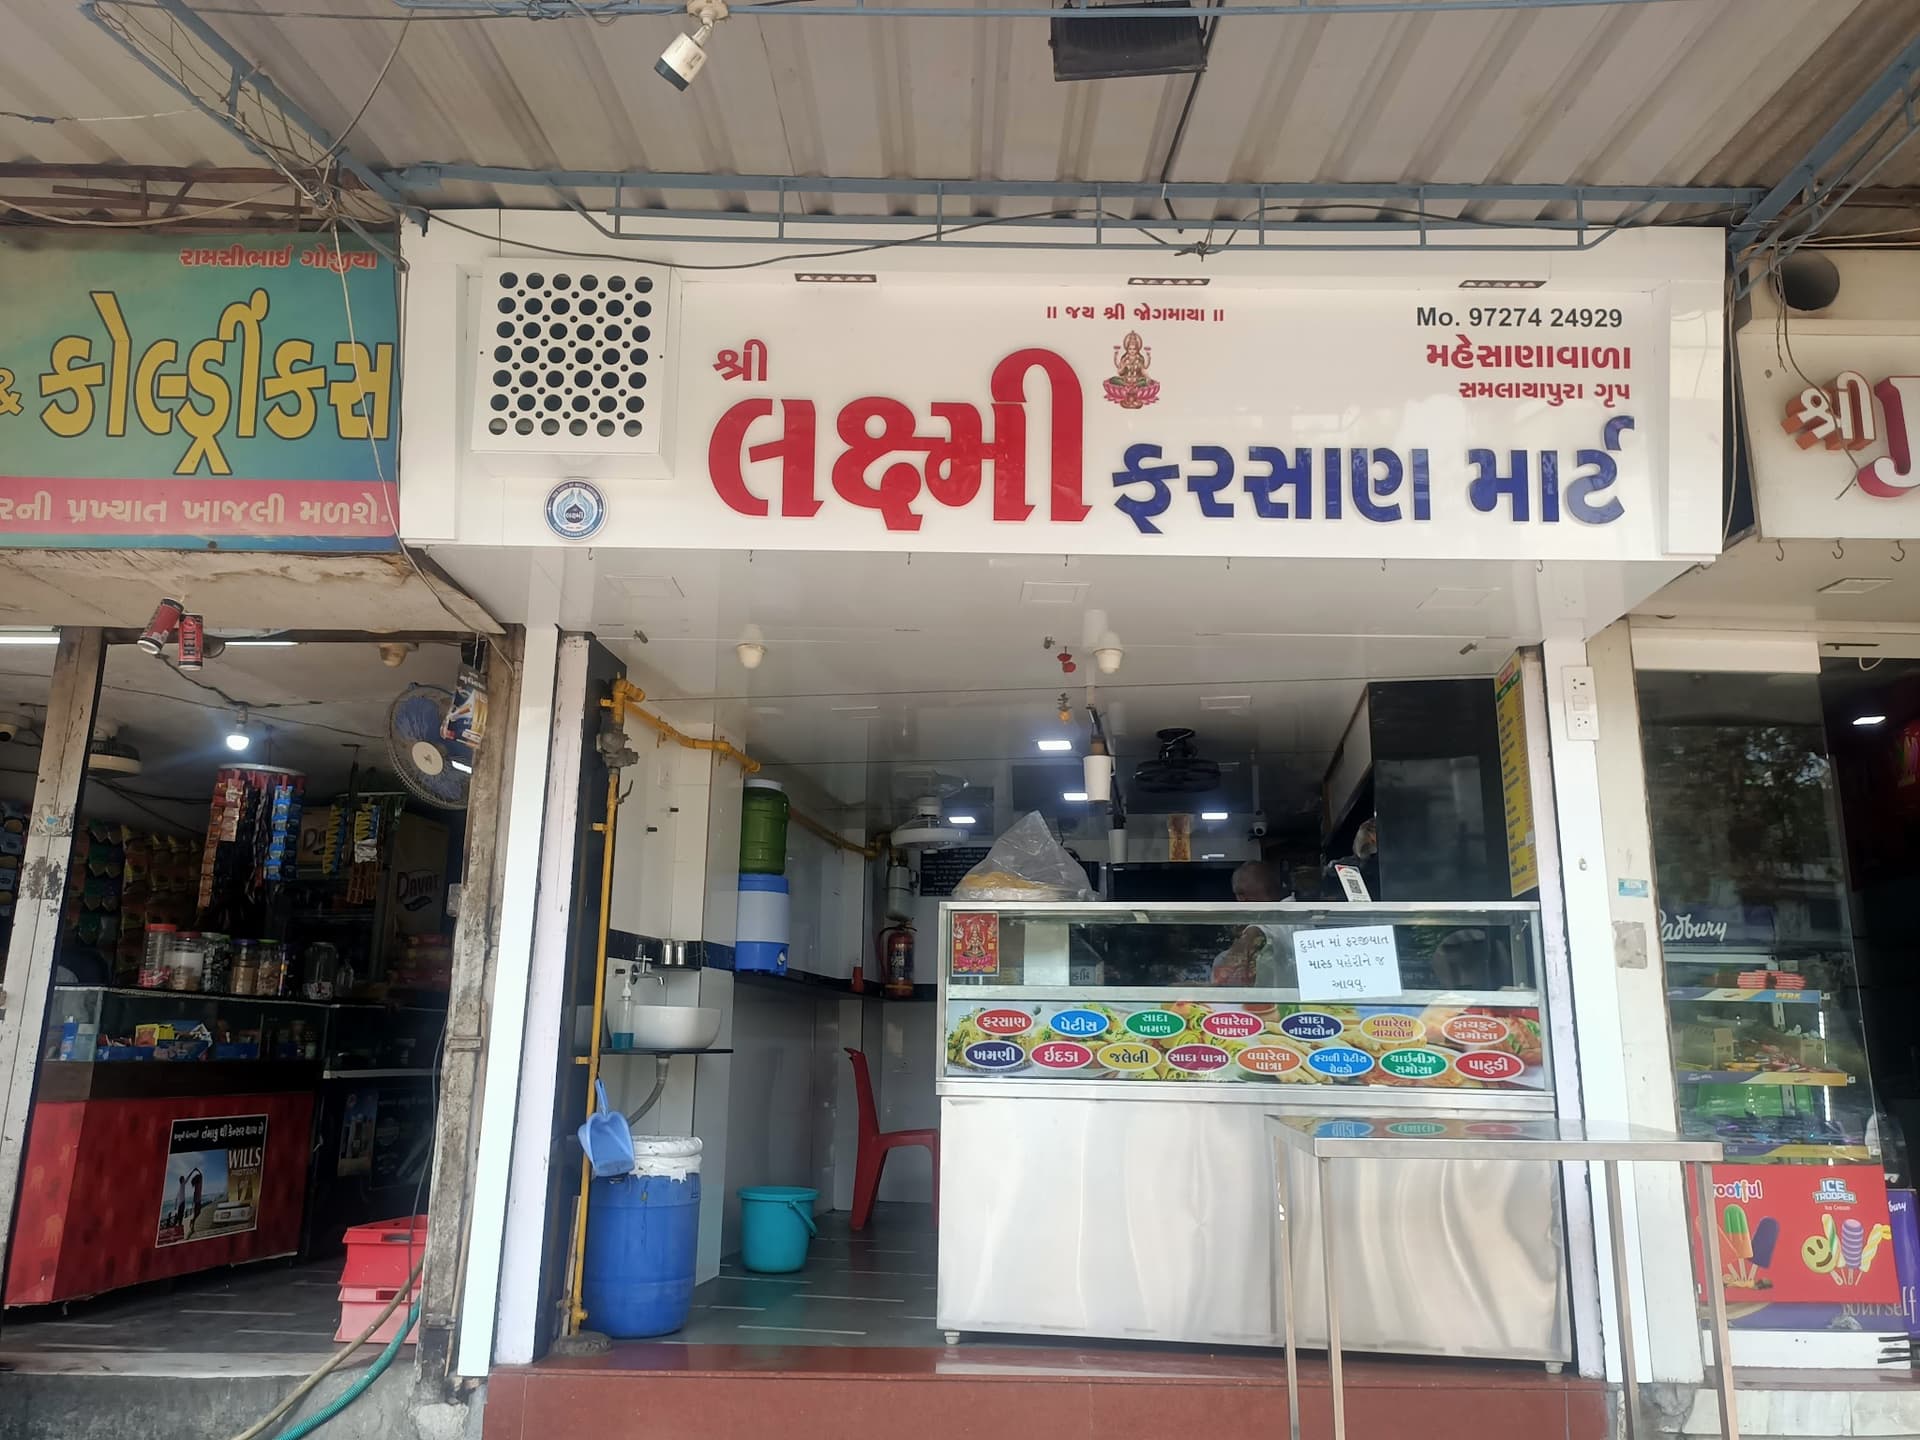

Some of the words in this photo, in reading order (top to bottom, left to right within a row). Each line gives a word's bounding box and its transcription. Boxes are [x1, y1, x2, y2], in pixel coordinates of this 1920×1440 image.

[180, 243, 294, 267] રામસીભાઈ
[1065, 306, 1095, 319] જય
[1103, 303, 1125, 320] શ્રી
[1133, 303, 1205, 321] જોગમાયા
[1416, 307, 1460, 326] Mo.
[1469, 308, 1542, 327] 97274
[1550, 308, 1623, 328] 24929
[1426, 334, 1631, 370] મહેસાણાવાળા
[713, 339, 768, 382] શ્રી
[1459, 382, 1583, 407] સમલાયાપુરા
[1781, 371, 1876, 450] શ્રી
[708, 347, 1093, 532] લક્ષ્મી
[1112, 443, 1432, 535] ફરસાણ
[1468, 415, 1635, 524] માર્ટ
[66, 498, 168, 524] પ્રખ્યાત
[182, 491, 284, 524] ખાજલી
[982, 1016, 1026, 1028] ફરસાણ
[1060, 1017, 1097, 1032] પેટીસ
[1142, 1014, 1168, 1023] સાદા
[1211, 1015, 1254, 1026] વઘારેલા
[1298, 1016, 1325, 1025] સાદા
[1140, 1025, 1171, 1034] ખમણ
[1216, 1027, 1249, 1036] ખમણ
[1289, 1025, 1335, 1036] નાયલોન
[973, 1048, 1016, 1061] ખમણી
[1044, 1050, 1079, 1062] ઈદડા
[1109, 1048, 1149, 1064] જલેબી
[1170, 1053, 1197, 1062] સાદા
[1201, 1053, 1227, 1063] પાત્રા
[1255, 1061, 1282, 1071] પાત્રા
[228, 1147, 262, 1169] WILLS
[1822, 1180, 1845, 1192] ICE
[1815, 1192, 1855, 1202] TROOPER
